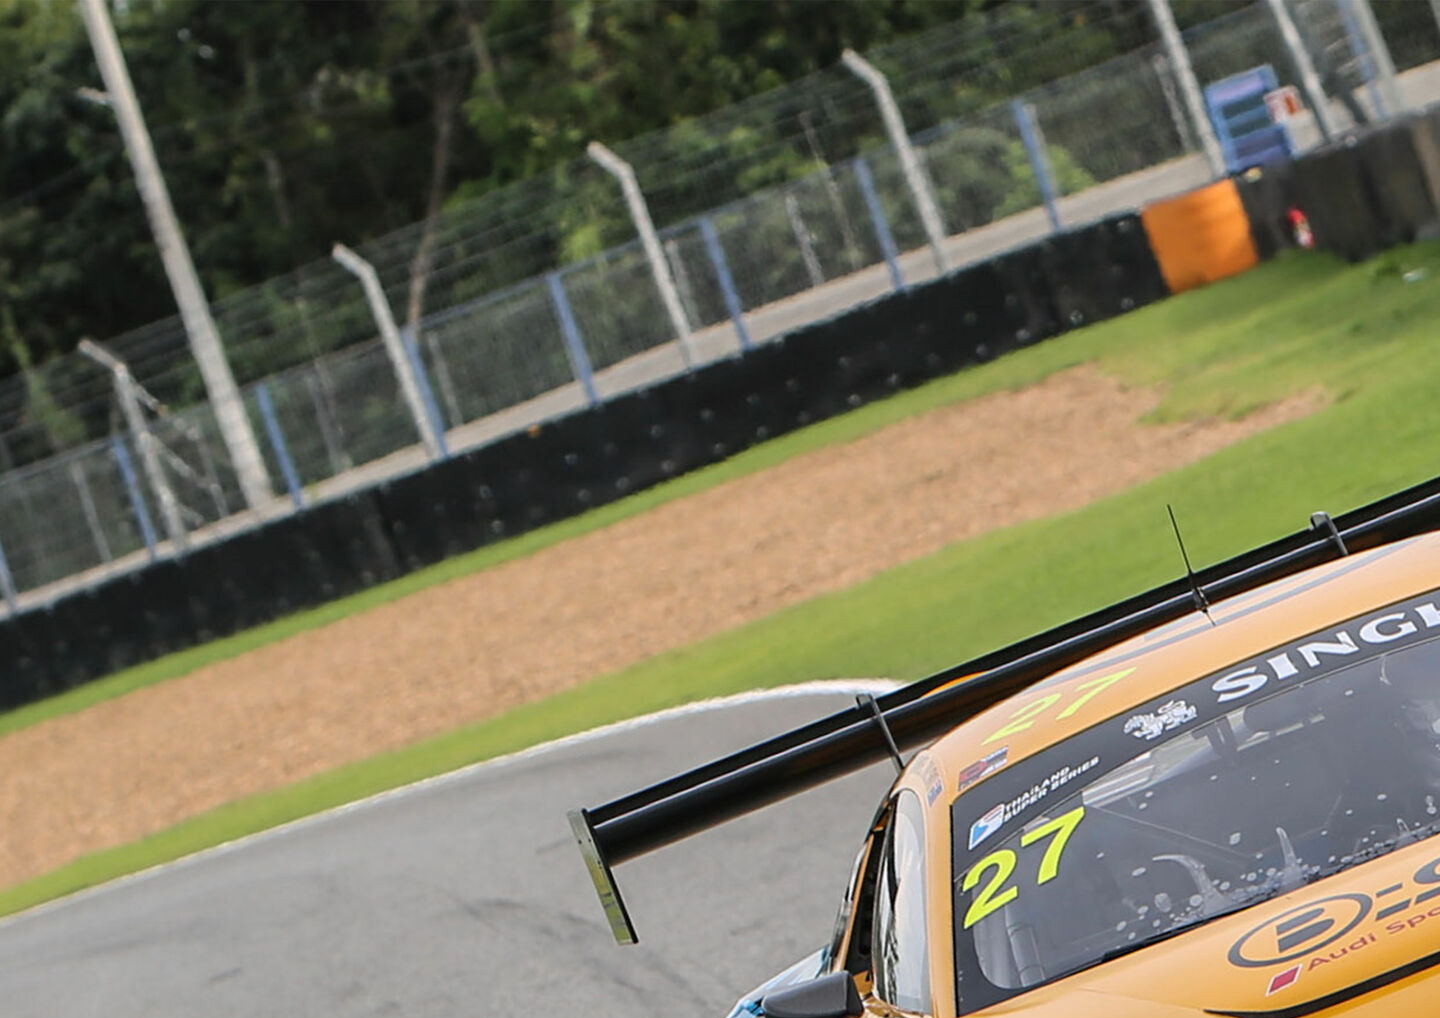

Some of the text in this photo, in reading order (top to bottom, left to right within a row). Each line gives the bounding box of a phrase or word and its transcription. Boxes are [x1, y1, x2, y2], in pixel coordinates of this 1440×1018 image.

[981, 666, 1137, 746] 27
[1004, 765, 1071, 812] THAILAND
[1004, 788, 1048, 823] SUPER
[1050, 756, 1100, 792] SERIES
[962, 806, 1086, 930] 27
[1308, 932, 1377, 971] Audi
